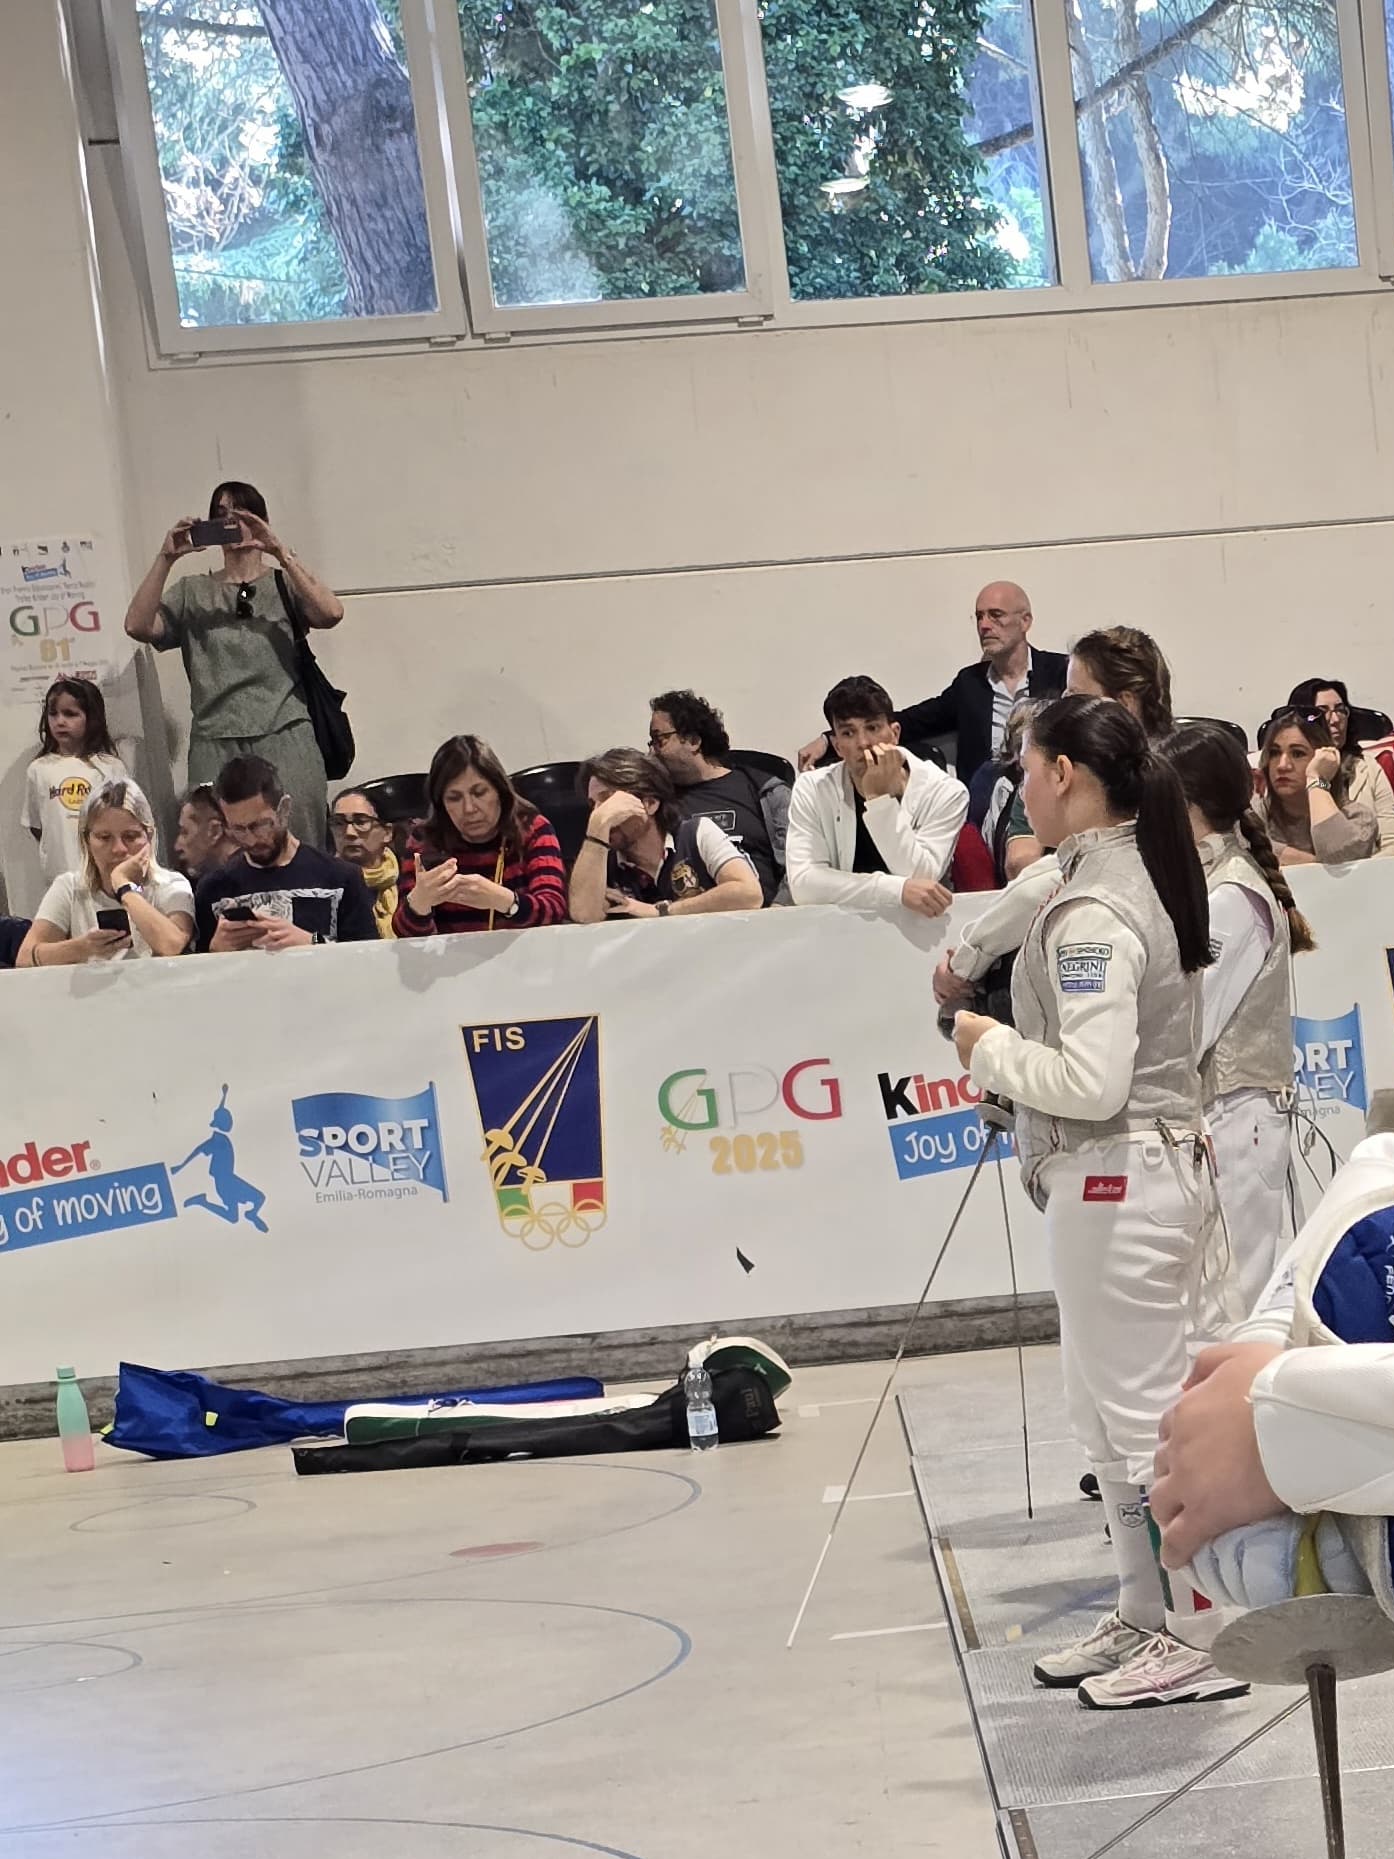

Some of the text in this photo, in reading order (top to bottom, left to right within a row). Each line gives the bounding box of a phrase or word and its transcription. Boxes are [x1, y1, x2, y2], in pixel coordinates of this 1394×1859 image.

[9, 601, 101, 637] GPG
[471, 1026, 526, 1053] FIS
[658, 1058, 842, 1130] GPG
[299, 1119, 429, 1158] SPORT
[709, 1130, 805, 1175] 2025
[904, 1131, 957, 1163] Joy
[300, 1151, 430, 1188] VALLEY
[15, 1197, 44, 1233] of
[53, 1182, 163, 1226] moving
[315, 1186, 418, 1203] Emilia-Romagna
